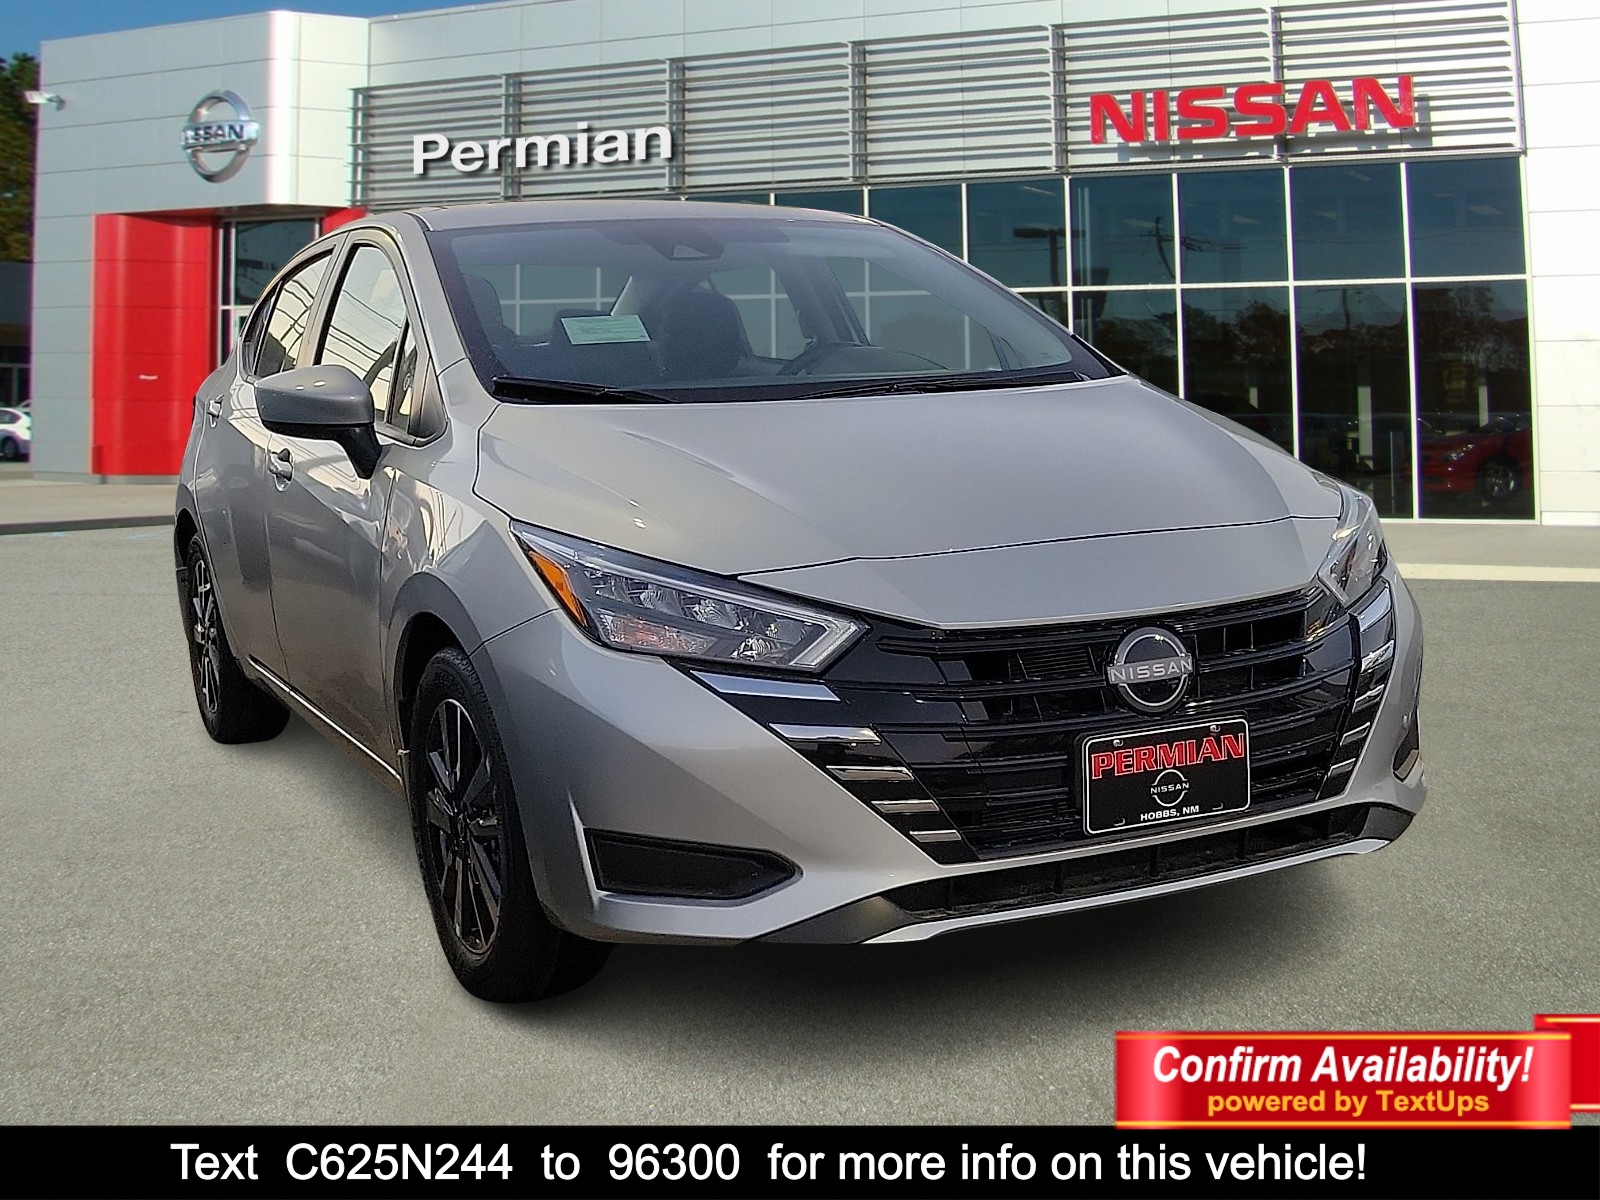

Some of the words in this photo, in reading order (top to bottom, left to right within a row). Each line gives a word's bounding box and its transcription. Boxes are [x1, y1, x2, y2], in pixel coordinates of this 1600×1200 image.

[1089, 74, 1415, 145] NISSAN
[413, 121, 673, 175] Permian
[1110, 658, 1193, 683] NISSAN
[1091, 732, 1245, 780] PERMIAN
[1150, 782, 1190, 794] NISSAN
[1140, 808, 1181, 822] HOBBS,
[1182, 805, 1200, 815] NM
